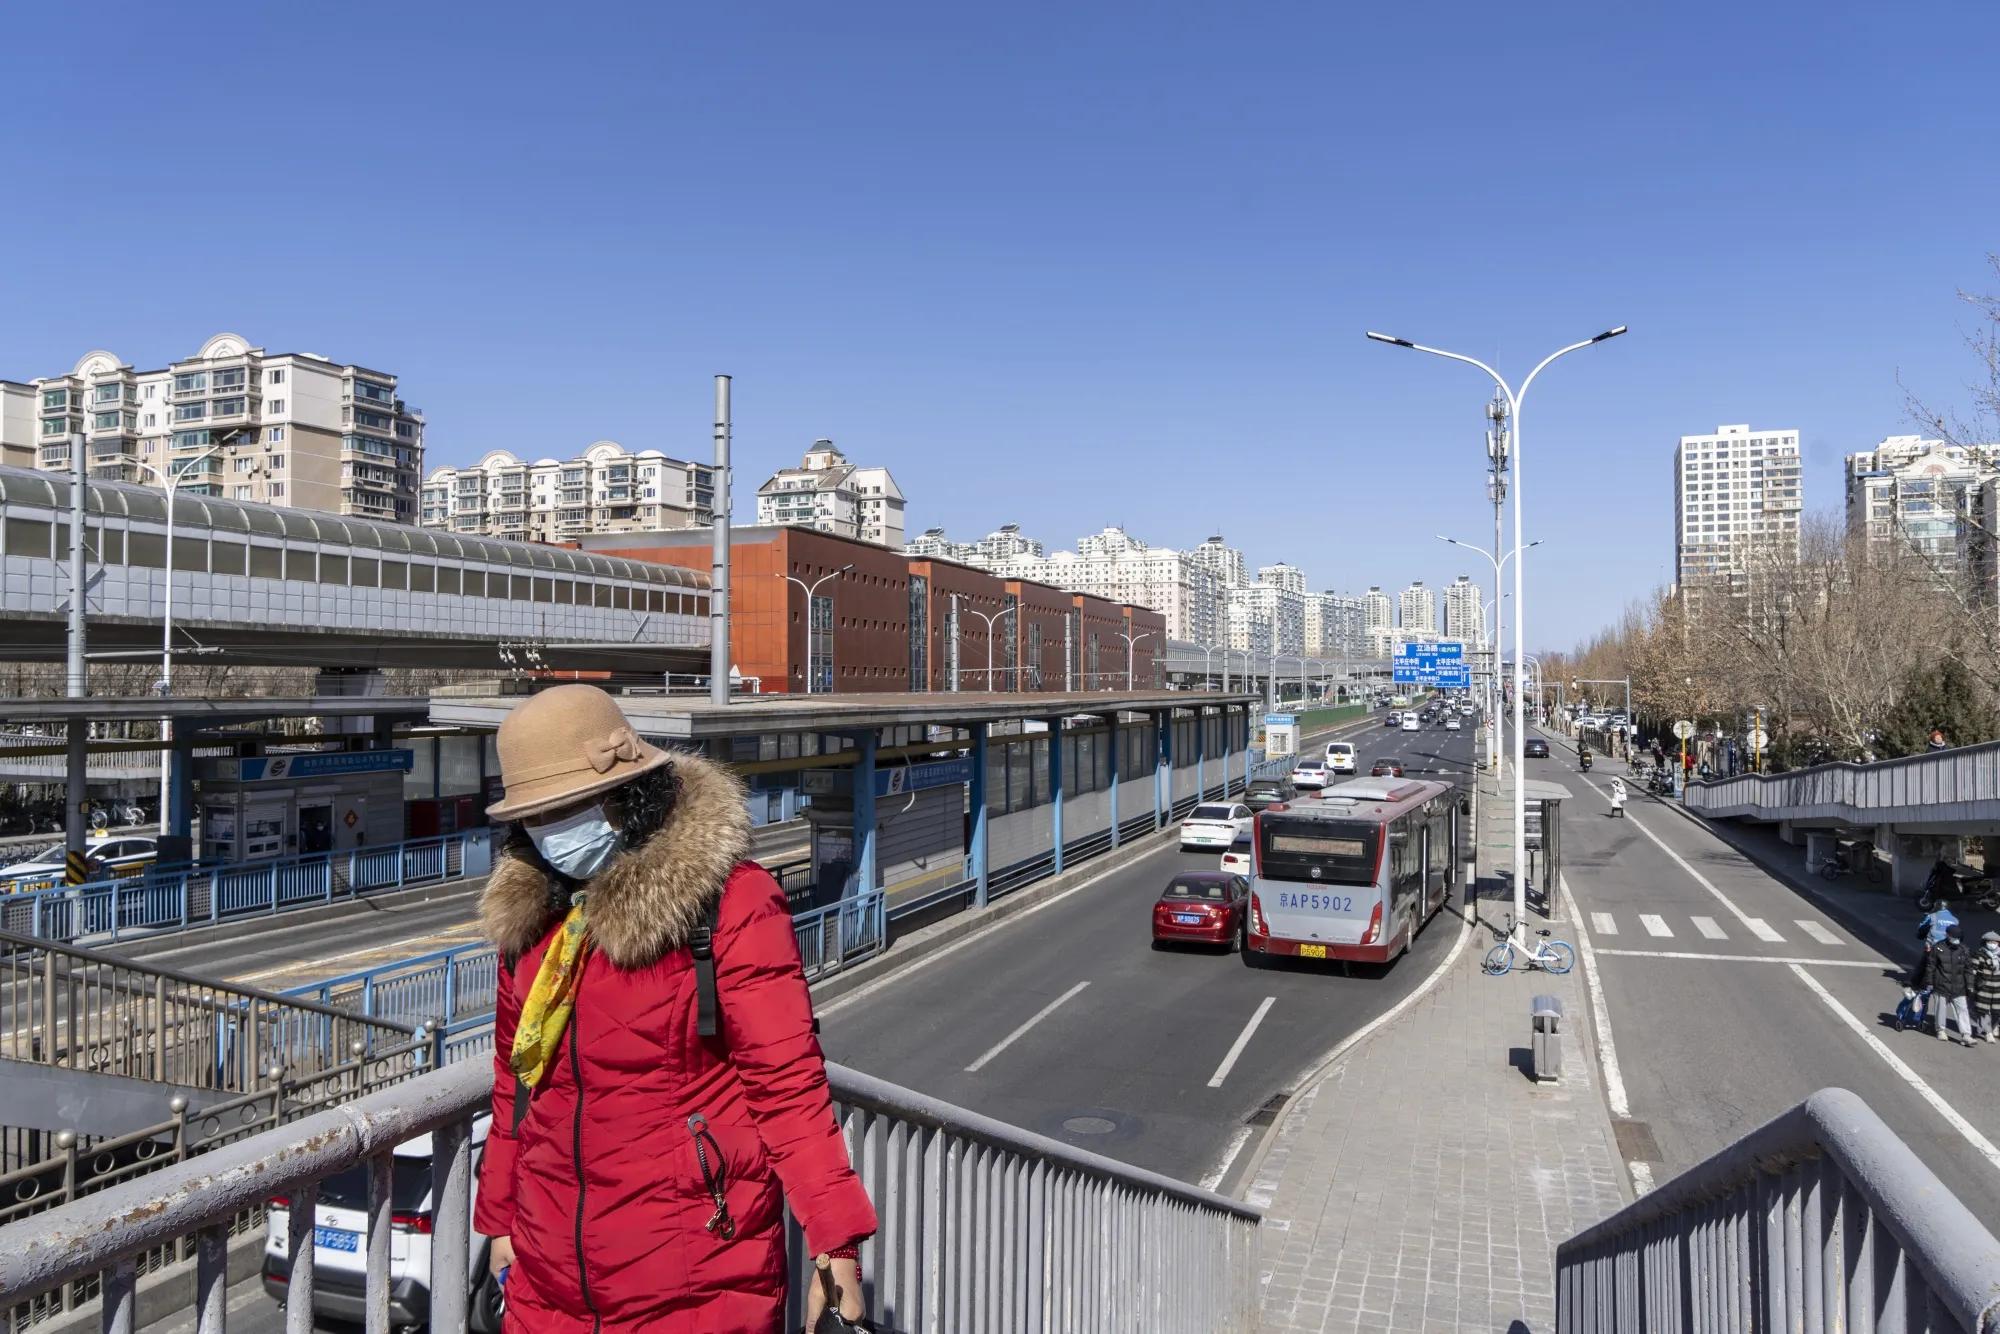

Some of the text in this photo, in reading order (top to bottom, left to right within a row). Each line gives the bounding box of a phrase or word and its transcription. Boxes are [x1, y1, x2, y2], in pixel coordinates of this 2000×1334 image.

[1416, 644, 1438, 652] 立汤路
[1394, 657, 1420, 666] 太平庄中街
[1435, 657, 1461, 666] 太平庄中街
[1279, 893, 1352, 912] 京AP5902
[1302, 948, 1325, 957] P5902
